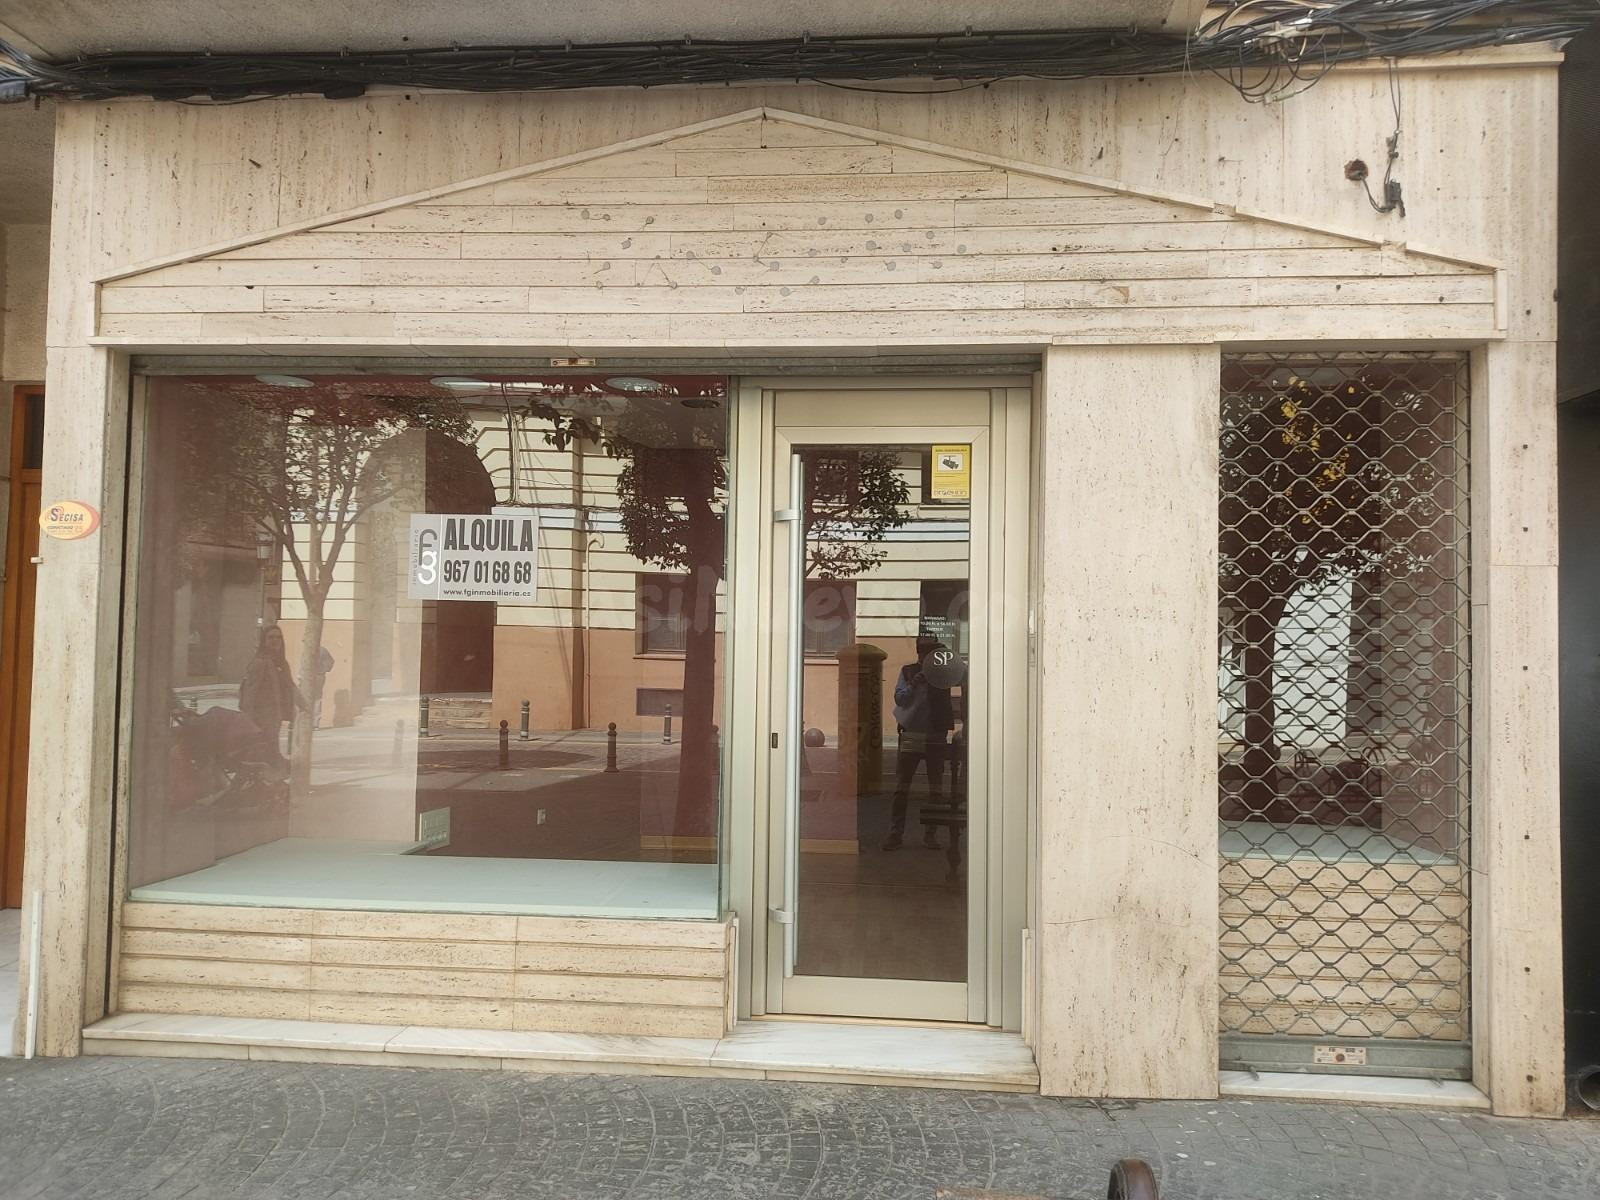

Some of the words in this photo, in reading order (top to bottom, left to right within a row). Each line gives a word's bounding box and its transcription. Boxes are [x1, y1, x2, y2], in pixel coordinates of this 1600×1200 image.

[444, 519, 533, 552] ALQUILA
[444, 560, 470, 583] 967
[474, 561, 488, 583] 01
[493, 561, 510, 584] 68
[514, 561, 532, 584] 68
